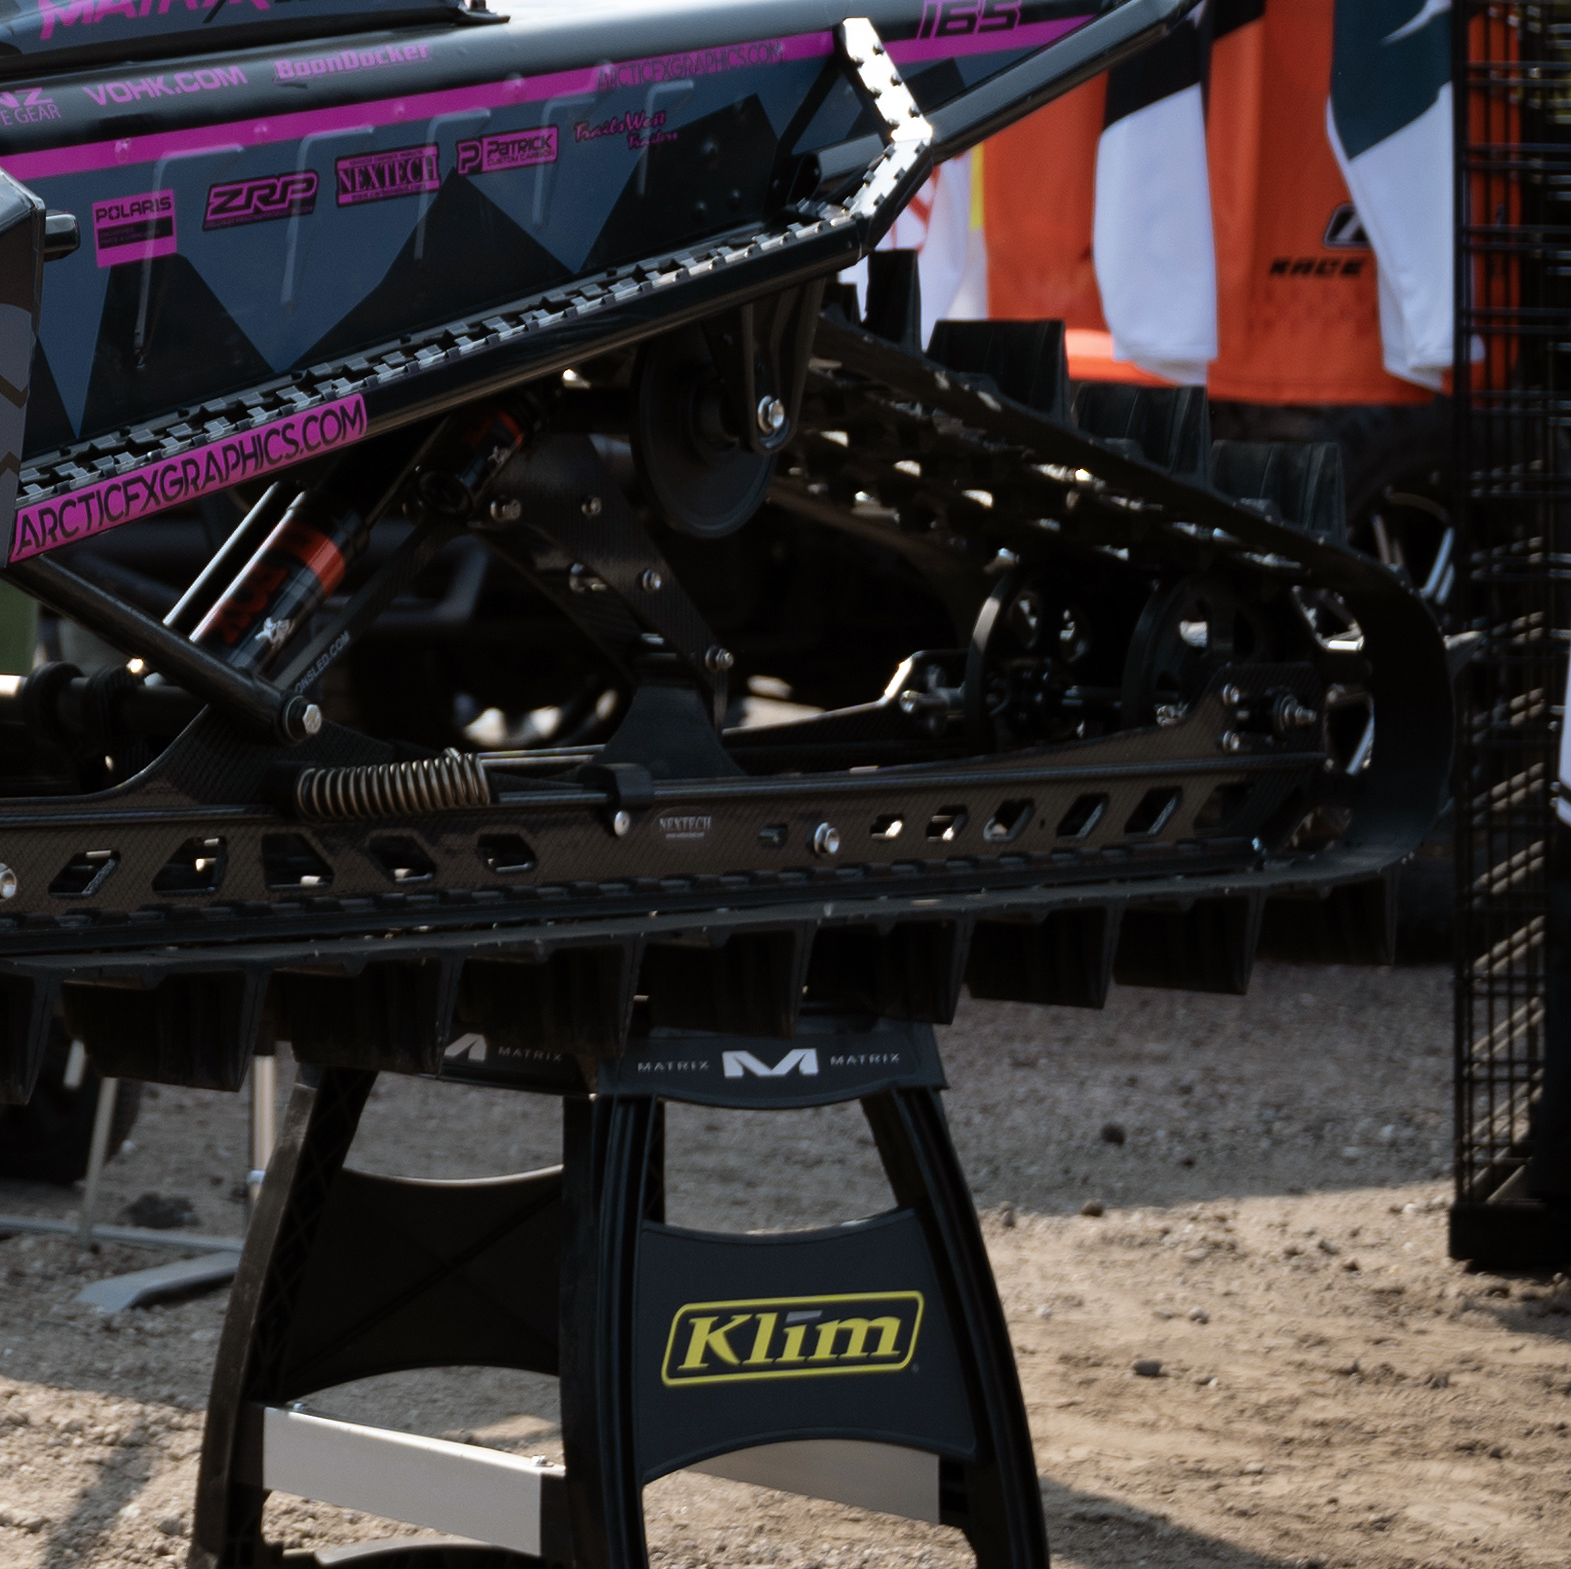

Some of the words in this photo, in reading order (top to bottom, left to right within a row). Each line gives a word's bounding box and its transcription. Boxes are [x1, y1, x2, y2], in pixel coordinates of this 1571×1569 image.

[274, 44, 431, 82] BoonDocker
[83, 65, 249, 106] VOHK.COM
[16, 103, 61, 124] GEAR
[338, 154, 438, 195] NEXTECH
[96, 195, 172, 223] POLARIS
[209, 174, 320, 217] ZRP
[16, 398, 364, 557] ARCTICFXGRAPHICS.COM
[498, 1046, 563, 1063] MATRIX
[637, 1060, 710, 1073] MATRIX
[829, 1053, 901, 1067] MATRIX
[676, 1311, 903, 1371] Klim
